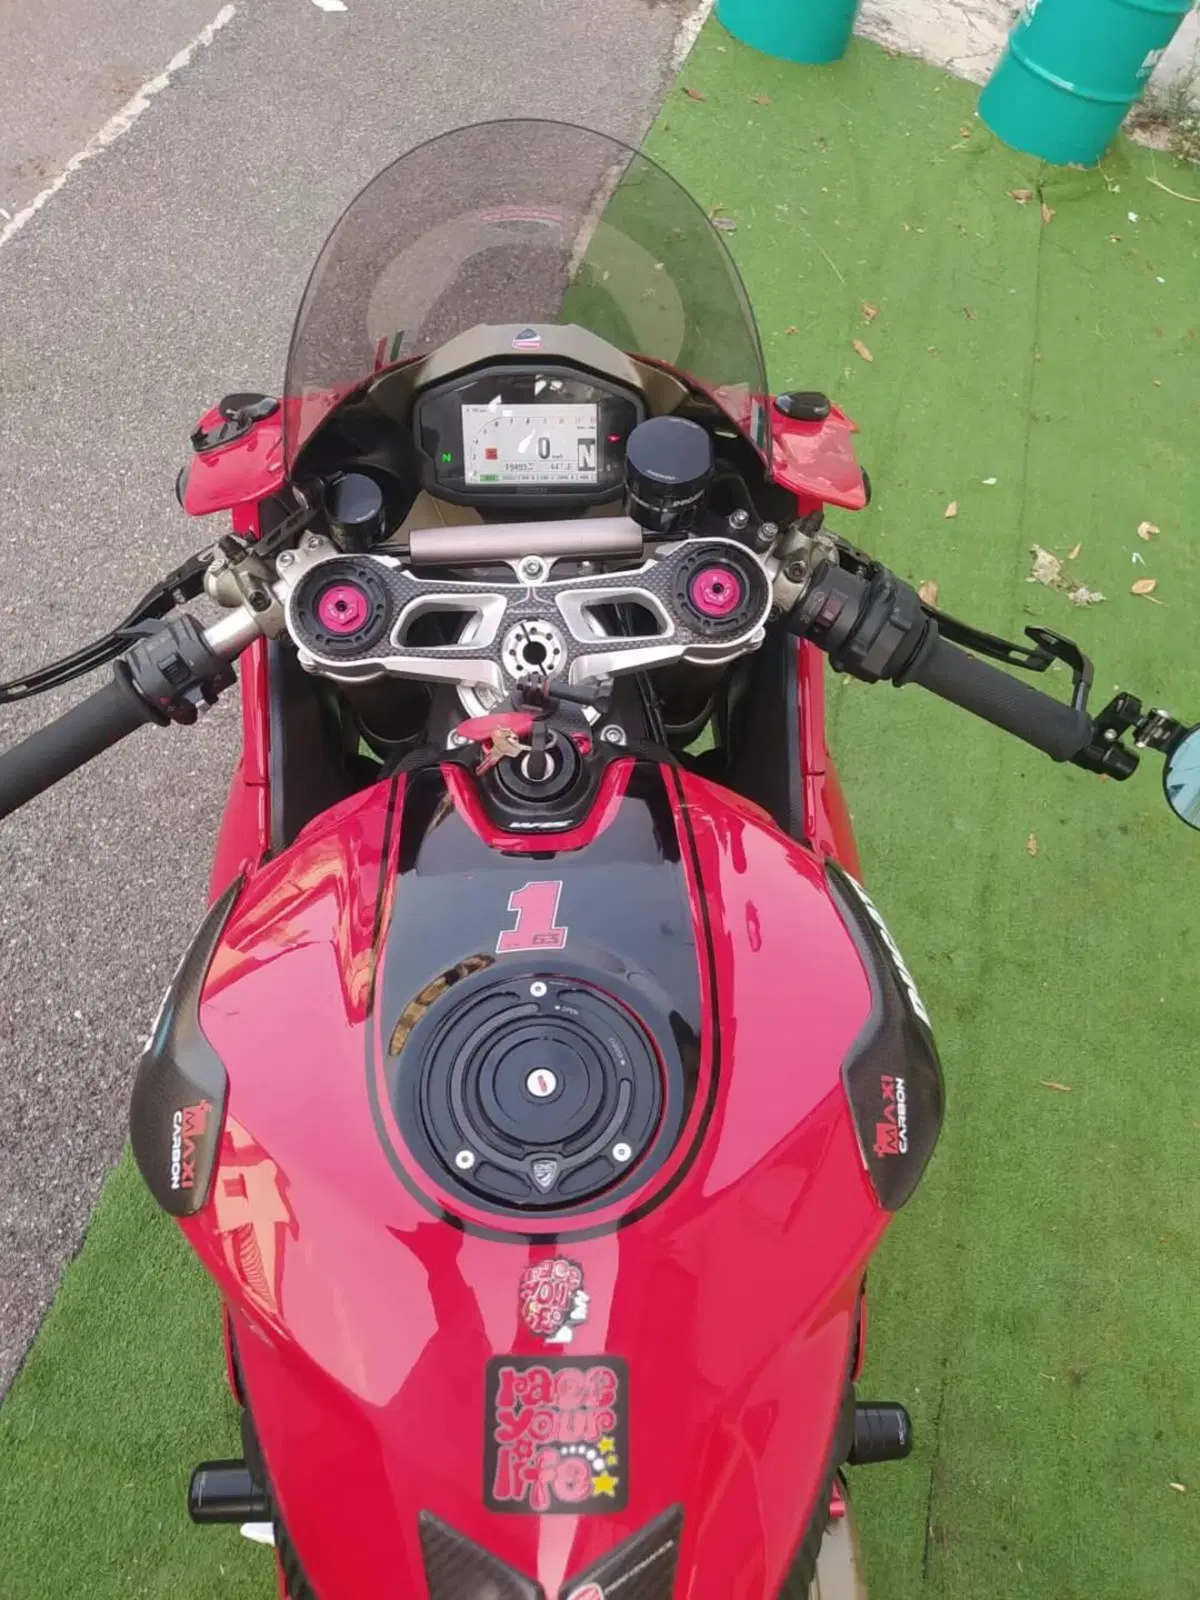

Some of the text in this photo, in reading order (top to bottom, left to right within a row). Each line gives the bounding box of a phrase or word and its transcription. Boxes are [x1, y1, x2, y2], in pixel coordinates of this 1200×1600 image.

[442, 452, 452, 463] N
[538, 437, 551, 459] 0
[578, 443, 596, 468] N
[495, 880, 569, 954] 1
[171, 1110, 182, 1189] CARBON
[181, 1107, 202, 1188] MAXI
[877, 1075, 898, 1151] MAXI
[896, 1077, 908, 1154] CARBON
[496, 1366, 618, 1408] race
[494, 1408, 617, 1444] your
[493, 1437, 592, 1511] life
